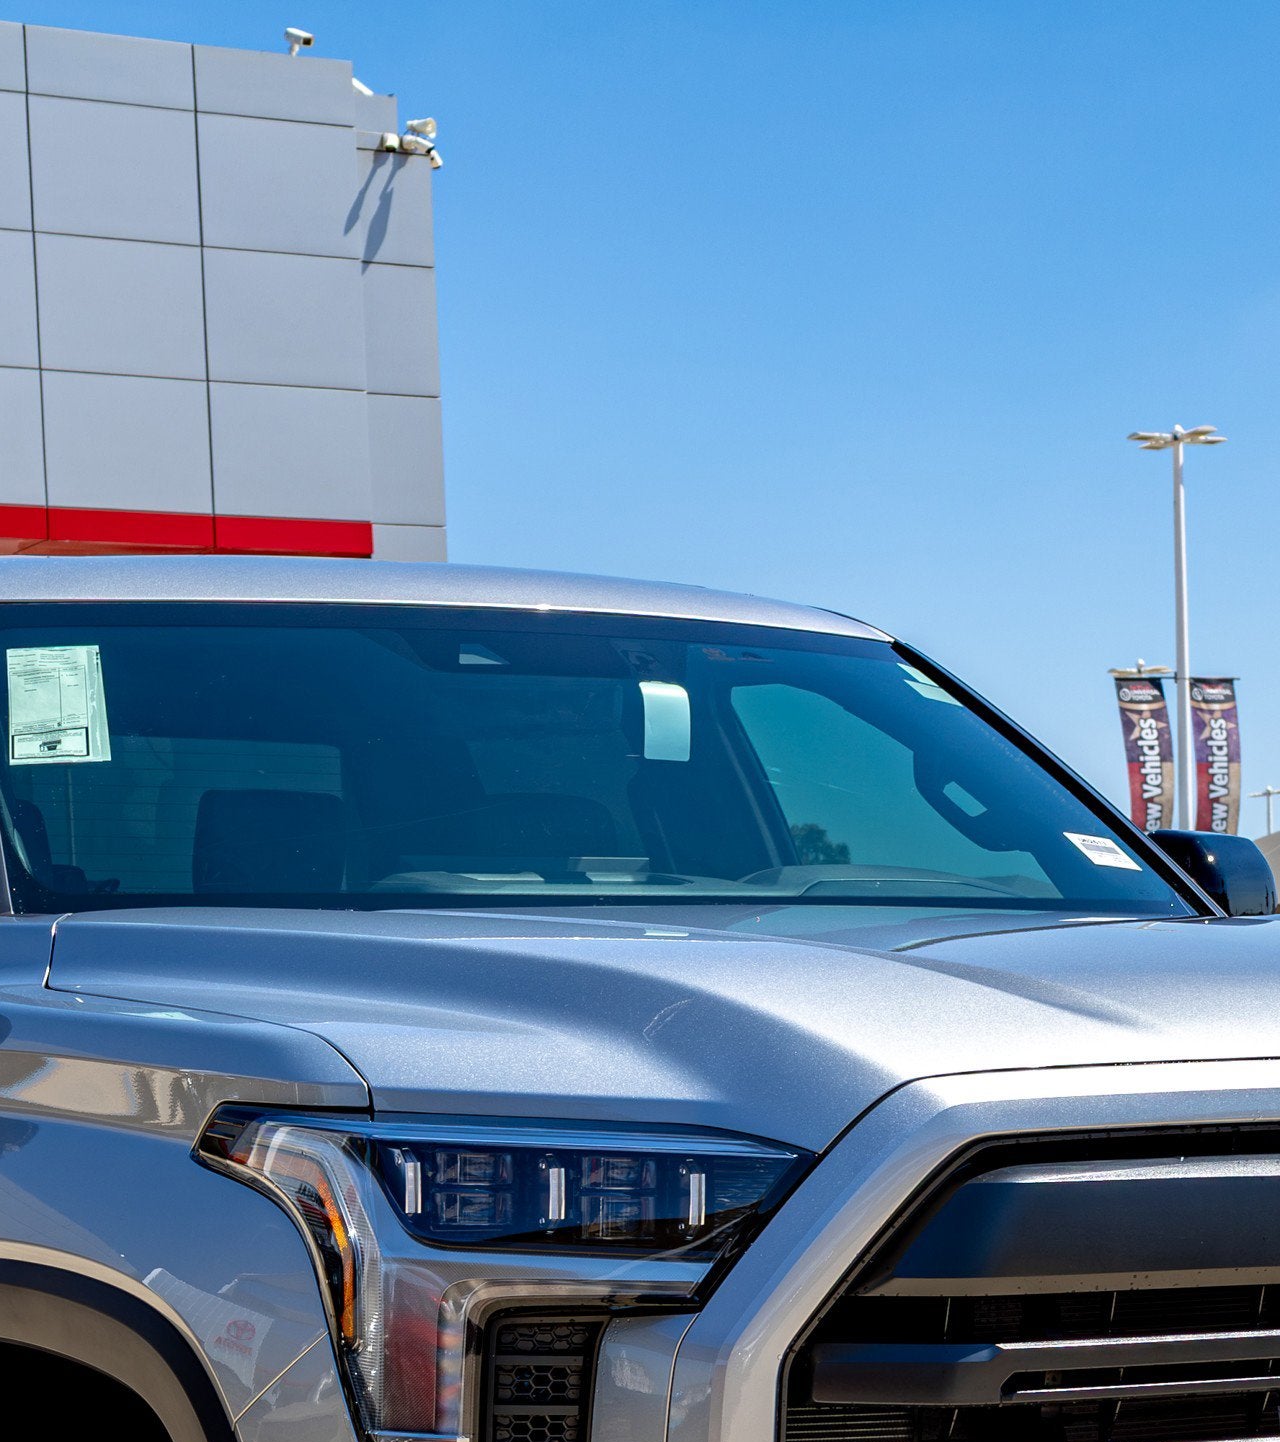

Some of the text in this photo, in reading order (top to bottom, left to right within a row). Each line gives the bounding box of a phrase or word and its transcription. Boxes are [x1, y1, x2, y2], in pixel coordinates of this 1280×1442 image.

[1138, 718, 1163, 835] ew Vehicles
[1208, 718, 1229, 834] ew Vehicles
